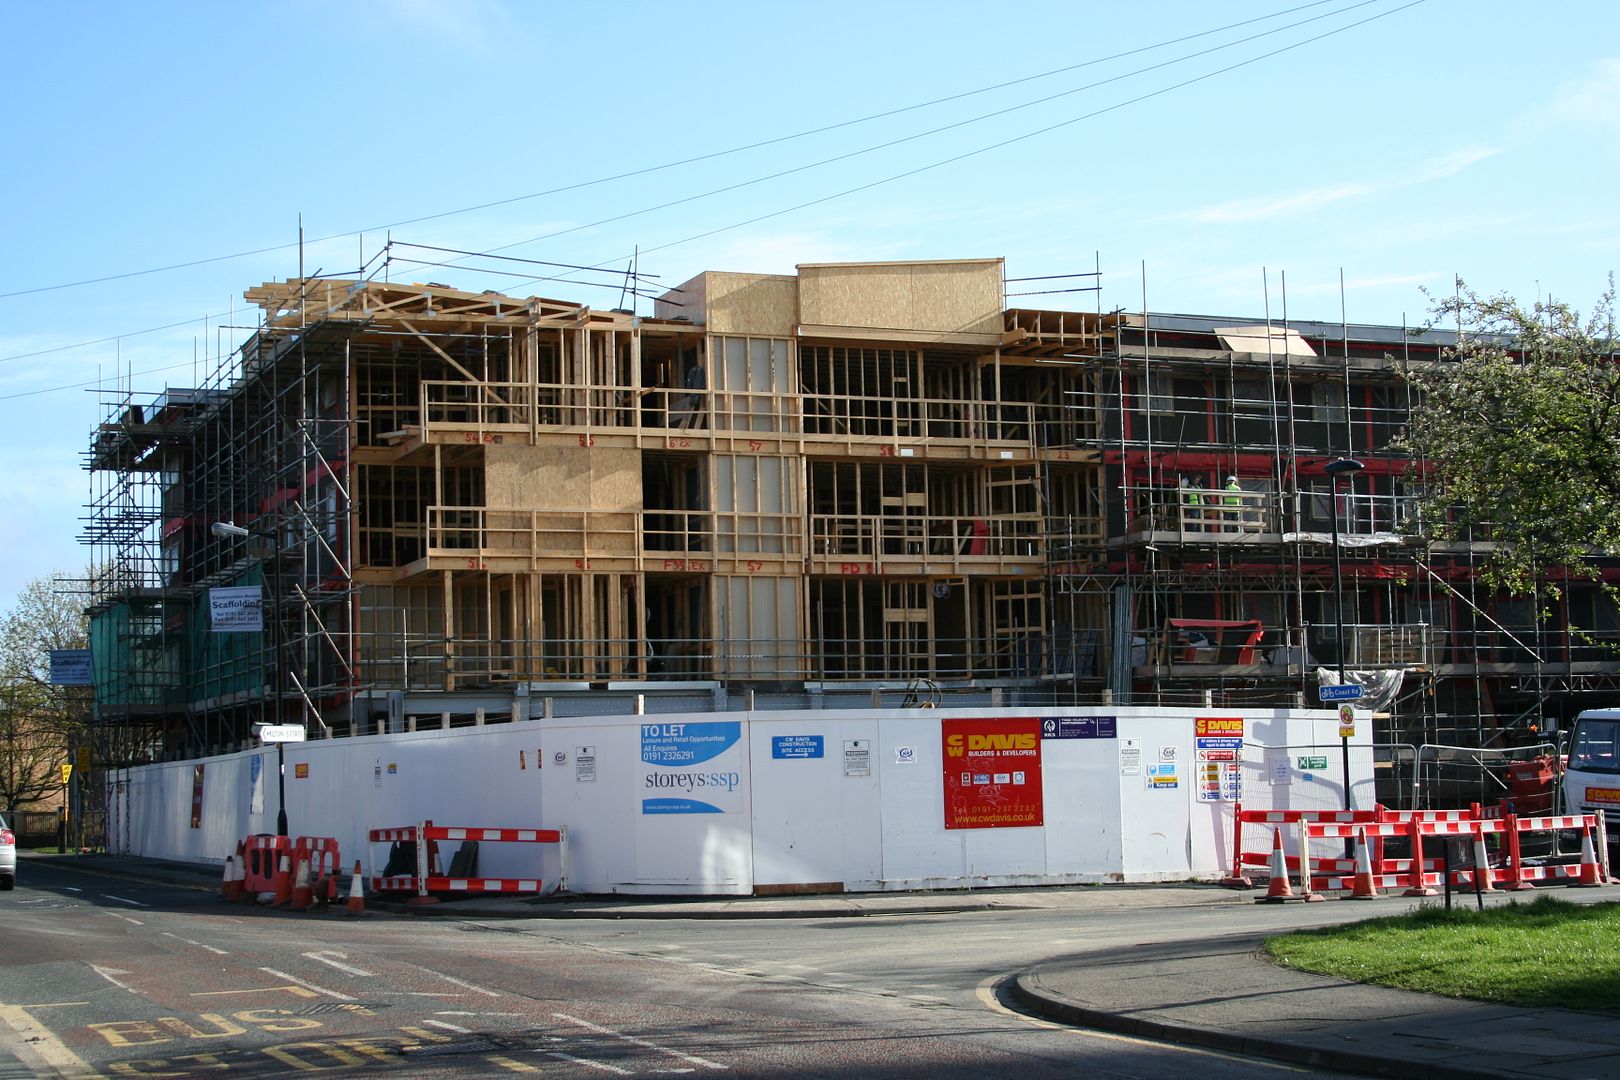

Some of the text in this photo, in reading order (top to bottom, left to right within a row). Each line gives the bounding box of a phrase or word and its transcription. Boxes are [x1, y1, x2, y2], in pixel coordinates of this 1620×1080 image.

[212, 599, 262, 609] Scaffolding
[1208, 720, 1242, 730] DAVIS
[642, 724, 686, 737] TO LET
[689, 736, 725, 744] Opportunities
[968, 733, 1037, 750] DAVIS
[643, 751, 694, 761] 0191 2326291
[1002, 749, 1037, 757] DEVELOPERS
[645, 771, 740, 793] storeys:ssp
[954, 813, 1036, 823] www.cwdavis.co.uk
[87, 1009, 324, 1048] BUS
